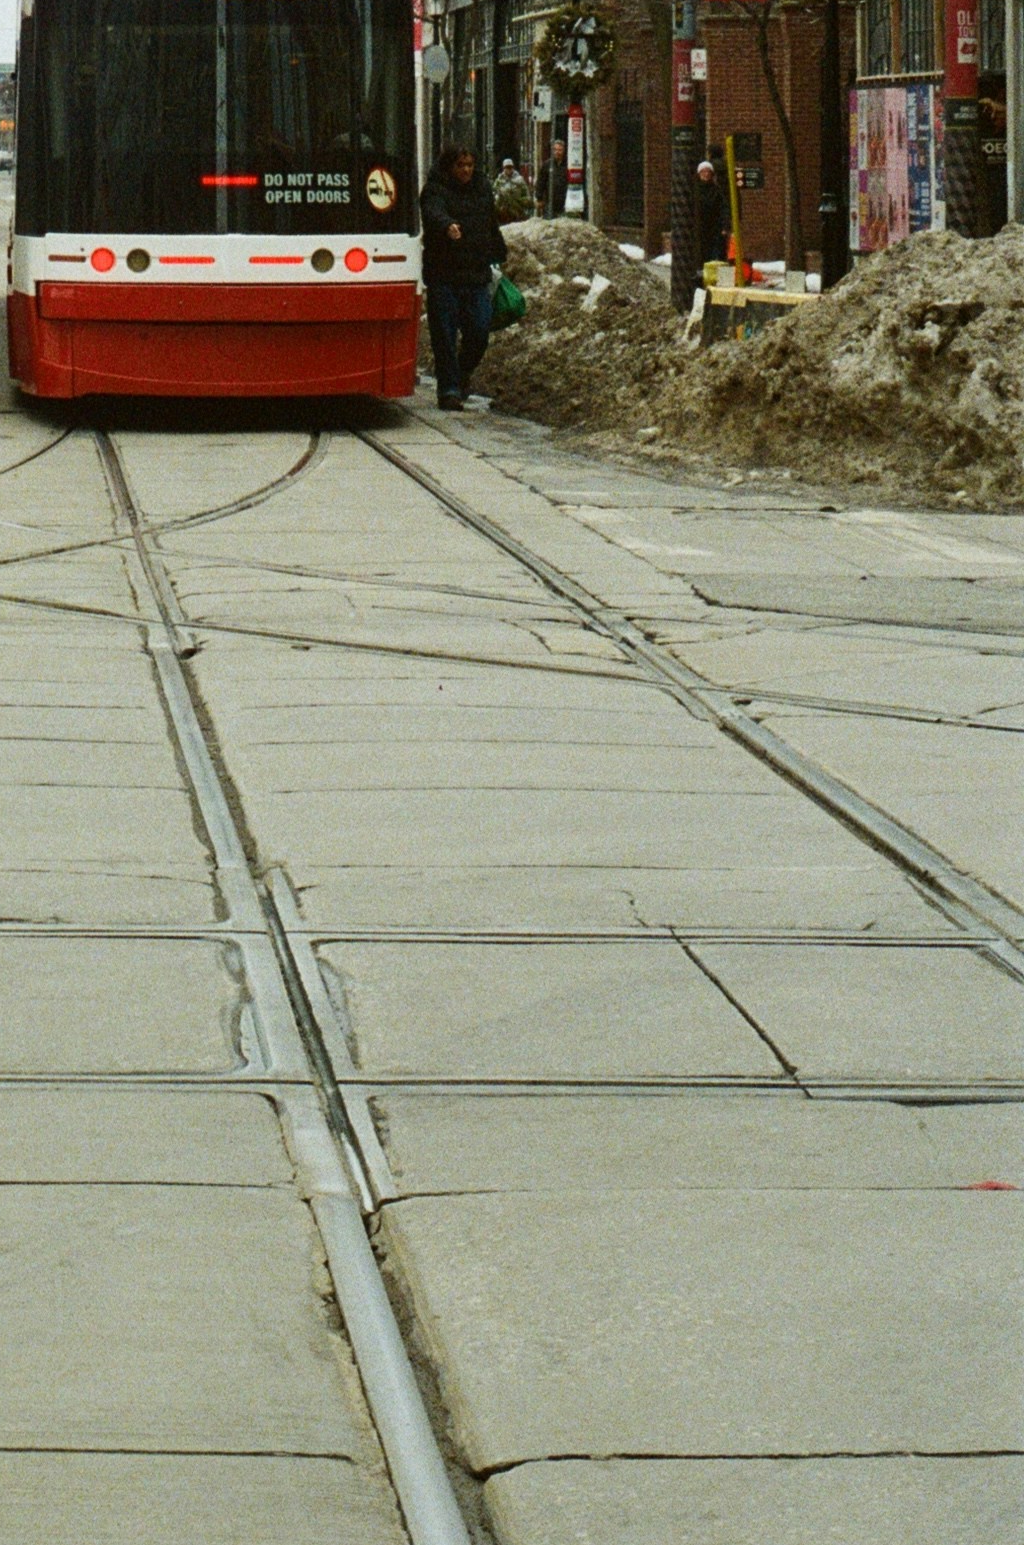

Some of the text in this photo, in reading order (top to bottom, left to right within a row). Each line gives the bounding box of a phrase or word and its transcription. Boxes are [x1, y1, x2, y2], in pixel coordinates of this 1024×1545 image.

[264, 173, 350, 187] DO NOT PASS
[265, 190, 351, 204] OPEN DOORS
